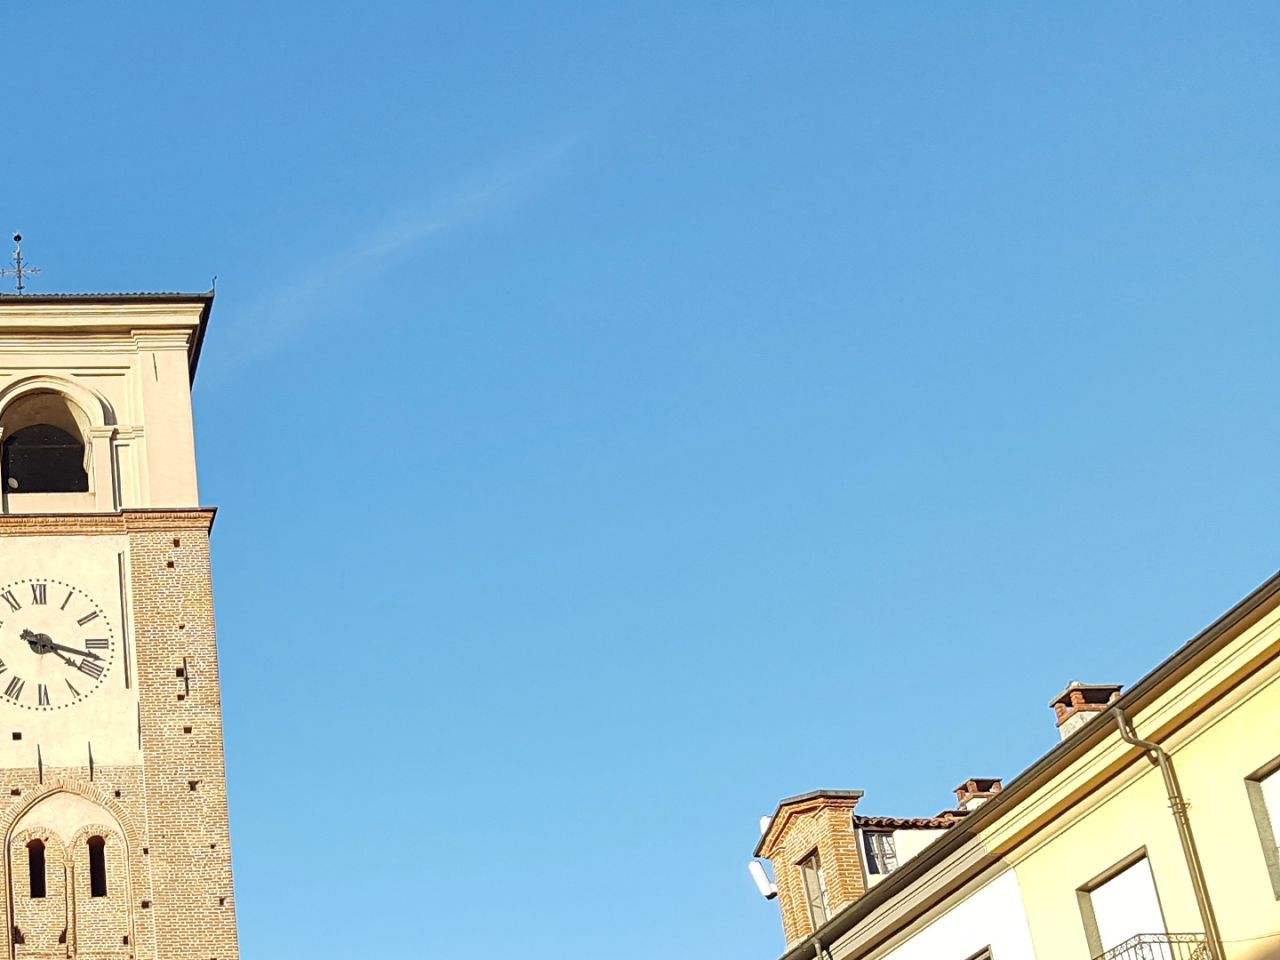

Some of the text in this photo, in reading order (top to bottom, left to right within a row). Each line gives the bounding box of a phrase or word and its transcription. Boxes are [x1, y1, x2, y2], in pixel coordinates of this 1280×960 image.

[1, 590, 22, 612] XI
[30, 583, 47, 605] XII
[60, 590, 74, 611] I
[76, 610, 99, 627] II
[85, 638, 109, 649] III
[4, 675, 25, 701] VII
[37, 683, 50, 706] VI
[64, 678, 81, 698] V
